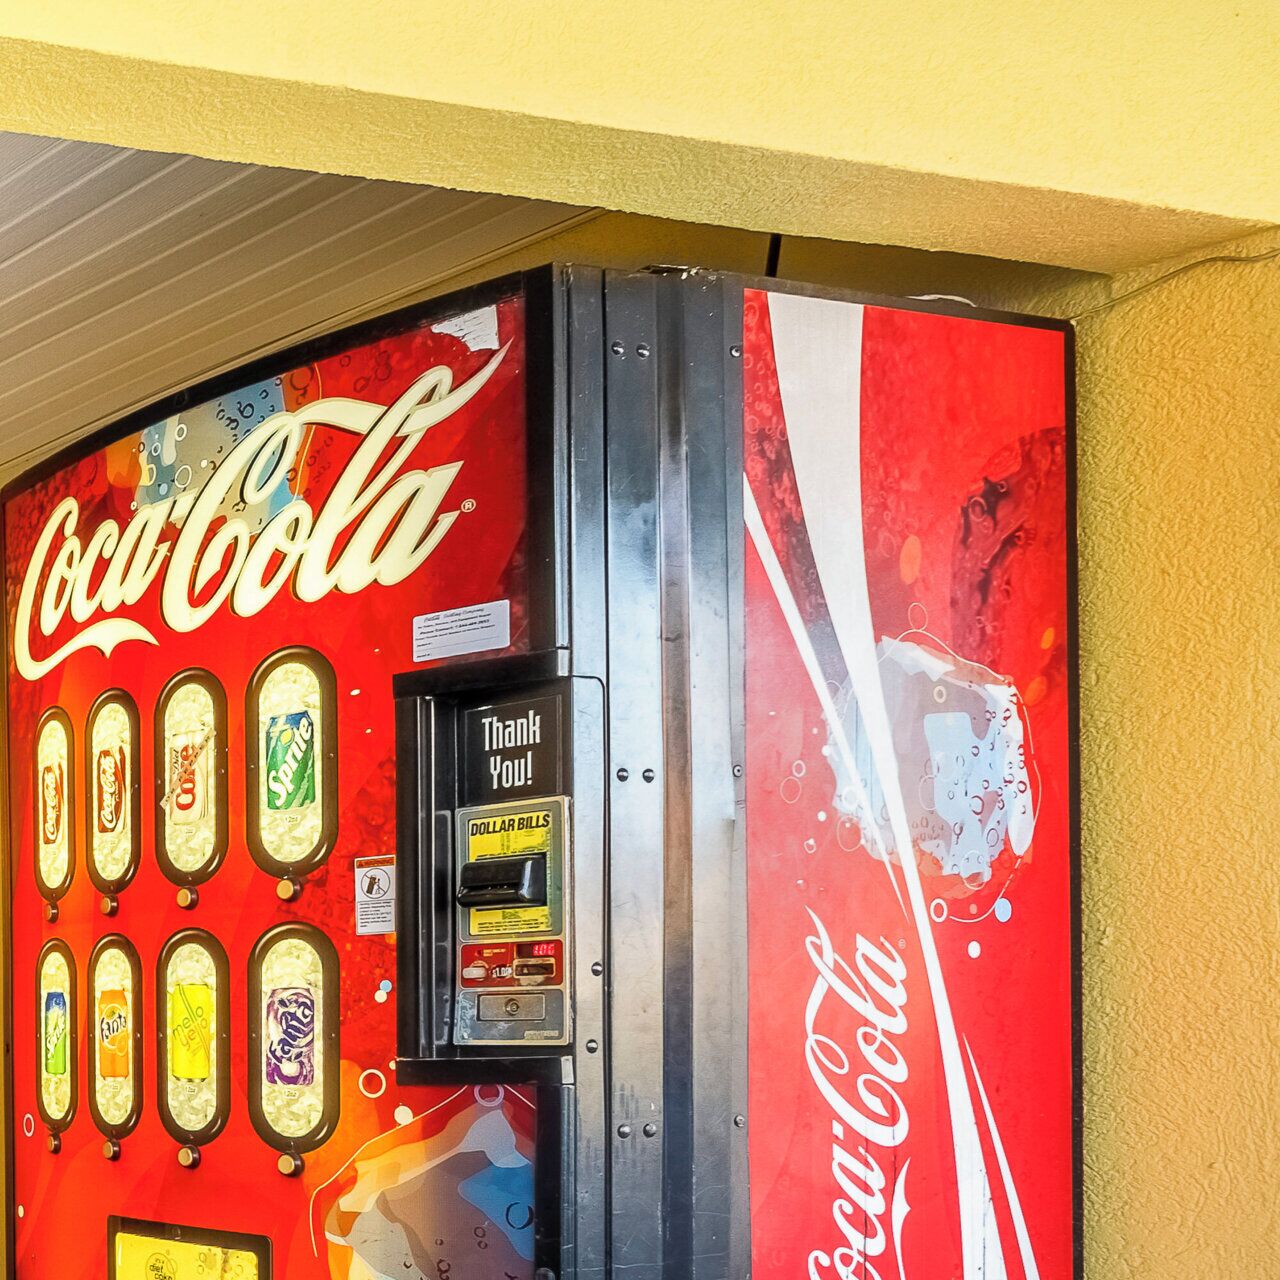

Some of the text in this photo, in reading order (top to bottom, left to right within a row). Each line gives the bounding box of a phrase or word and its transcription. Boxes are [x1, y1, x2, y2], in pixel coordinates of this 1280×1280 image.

[481, 709, 541, 752] Thank
[268, 716, 313, 807] Sprite
[489, 751, 533, 790] You!
[470, 813, 551, 837] DOLLAR BILLS
[172, 1006, 204, 1040] mello
[149, 1263, 164, 1274] diet
